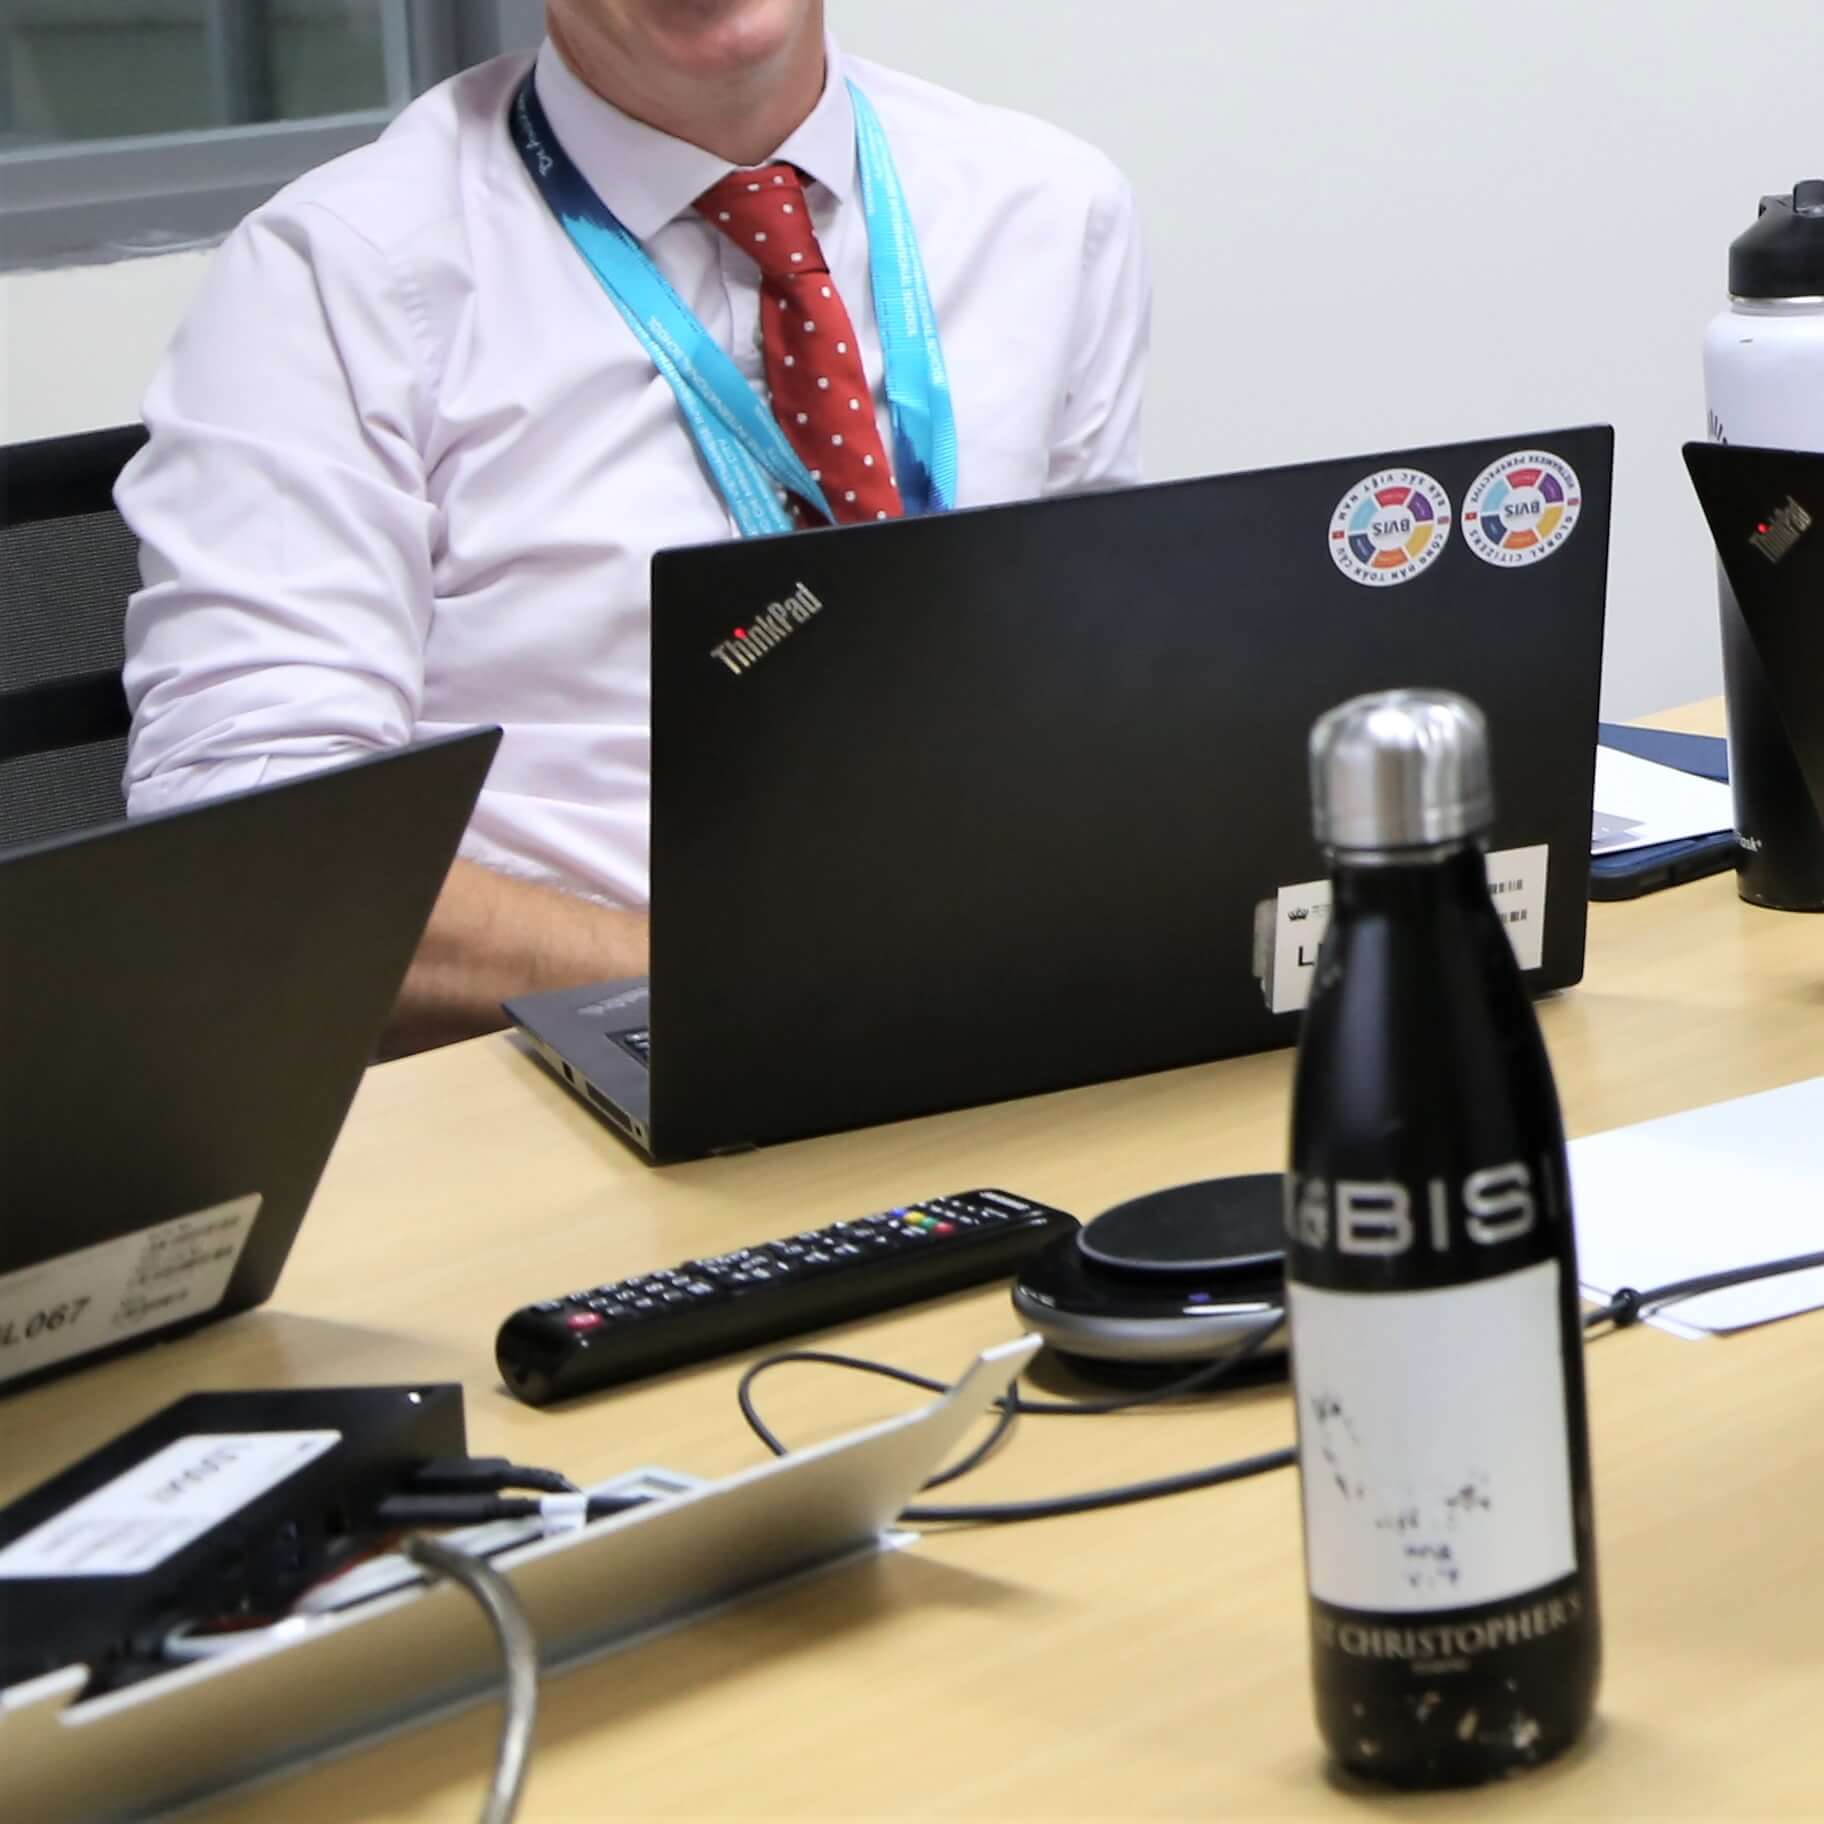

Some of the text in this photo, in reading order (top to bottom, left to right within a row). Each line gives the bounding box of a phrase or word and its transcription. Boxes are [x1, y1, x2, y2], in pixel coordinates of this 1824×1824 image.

[1505, 500, 1541, 518] BVIS
[1373, 518, 1411, 536] BVIS
[1470, 516, 1573, 563] GLOBAL CITIZENS
[710, 581, 823, 675] ThinkPad
